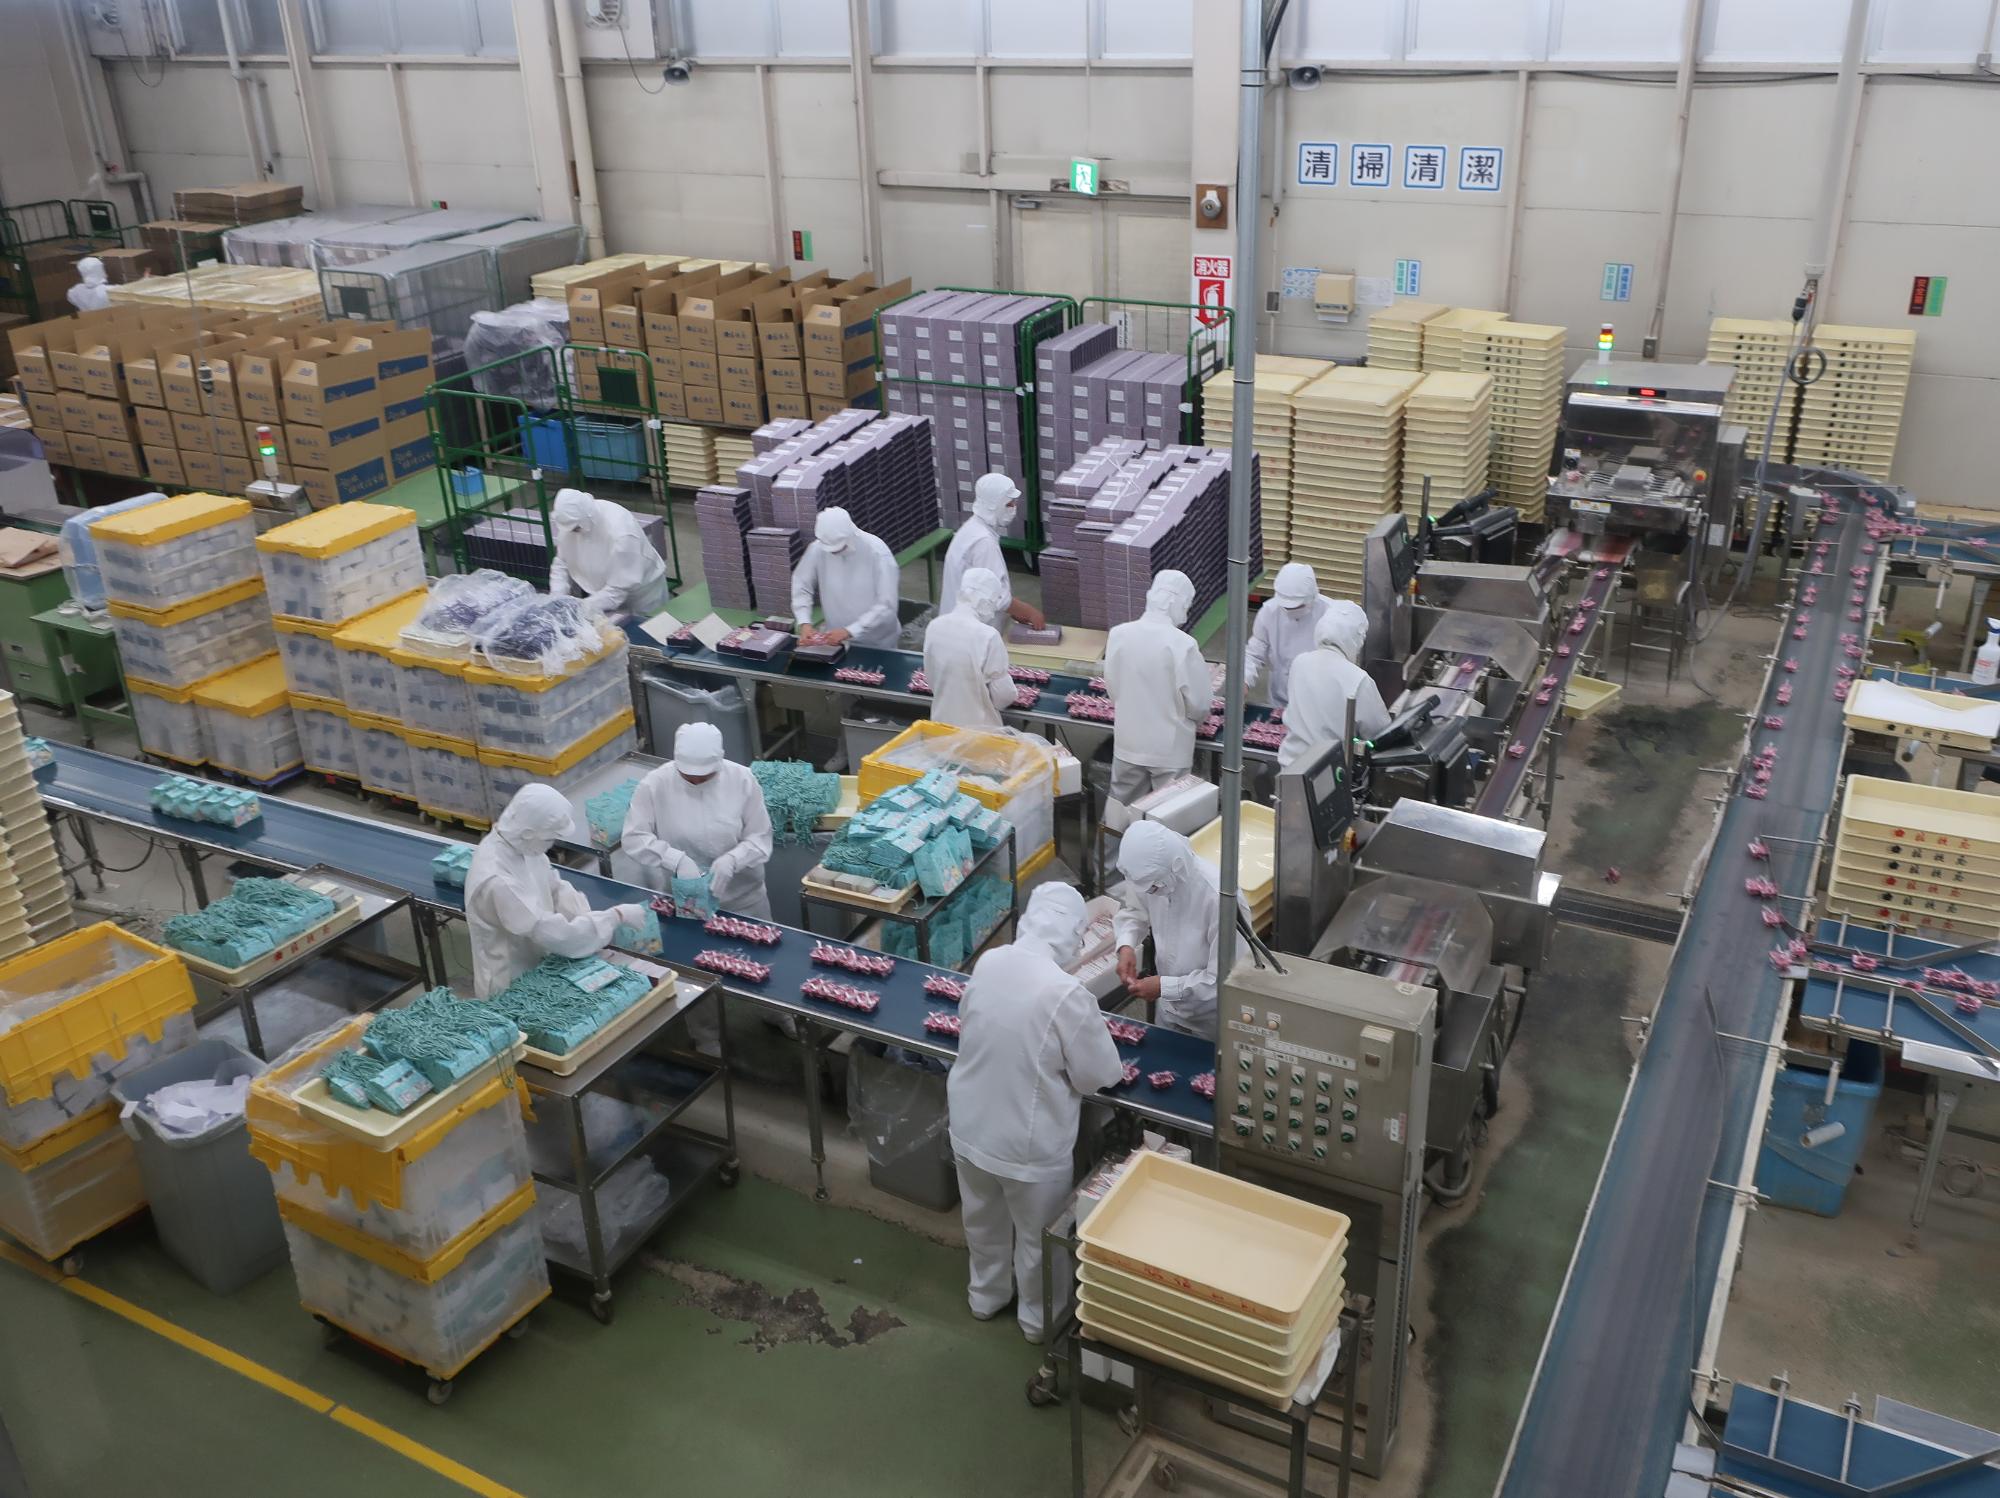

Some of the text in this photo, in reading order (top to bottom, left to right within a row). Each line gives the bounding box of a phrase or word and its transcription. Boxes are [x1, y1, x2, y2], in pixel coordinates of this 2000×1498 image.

[1304, 150, 1495, 184] 清掃清潔
[1195, 258, 1229, 277] 消火器
